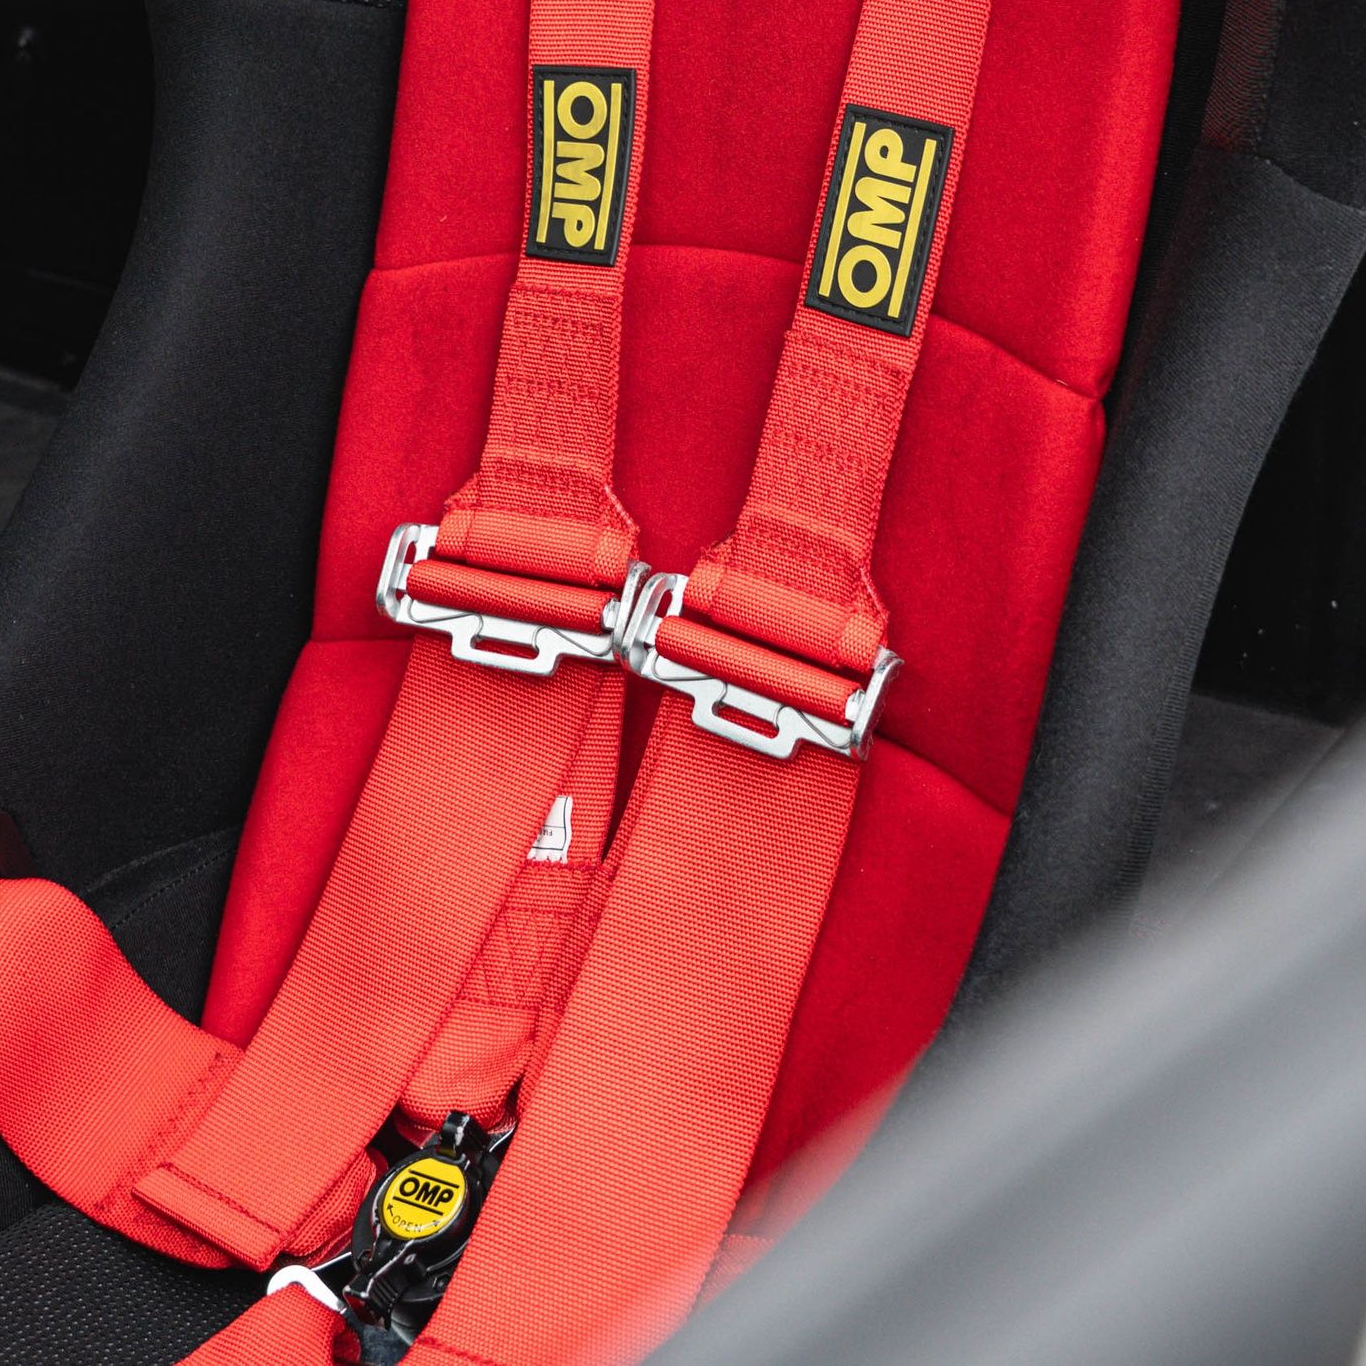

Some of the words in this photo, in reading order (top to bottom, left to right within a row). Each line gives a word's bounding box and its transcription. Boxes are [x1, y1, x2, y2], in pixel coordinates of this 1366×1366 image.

[551, 81, 608, 248] OMP
[837, 128, 917, 309] OMP
[392, 1214, 424, 1234] OPEN
[399, 1176, 455, 1208] OMP
